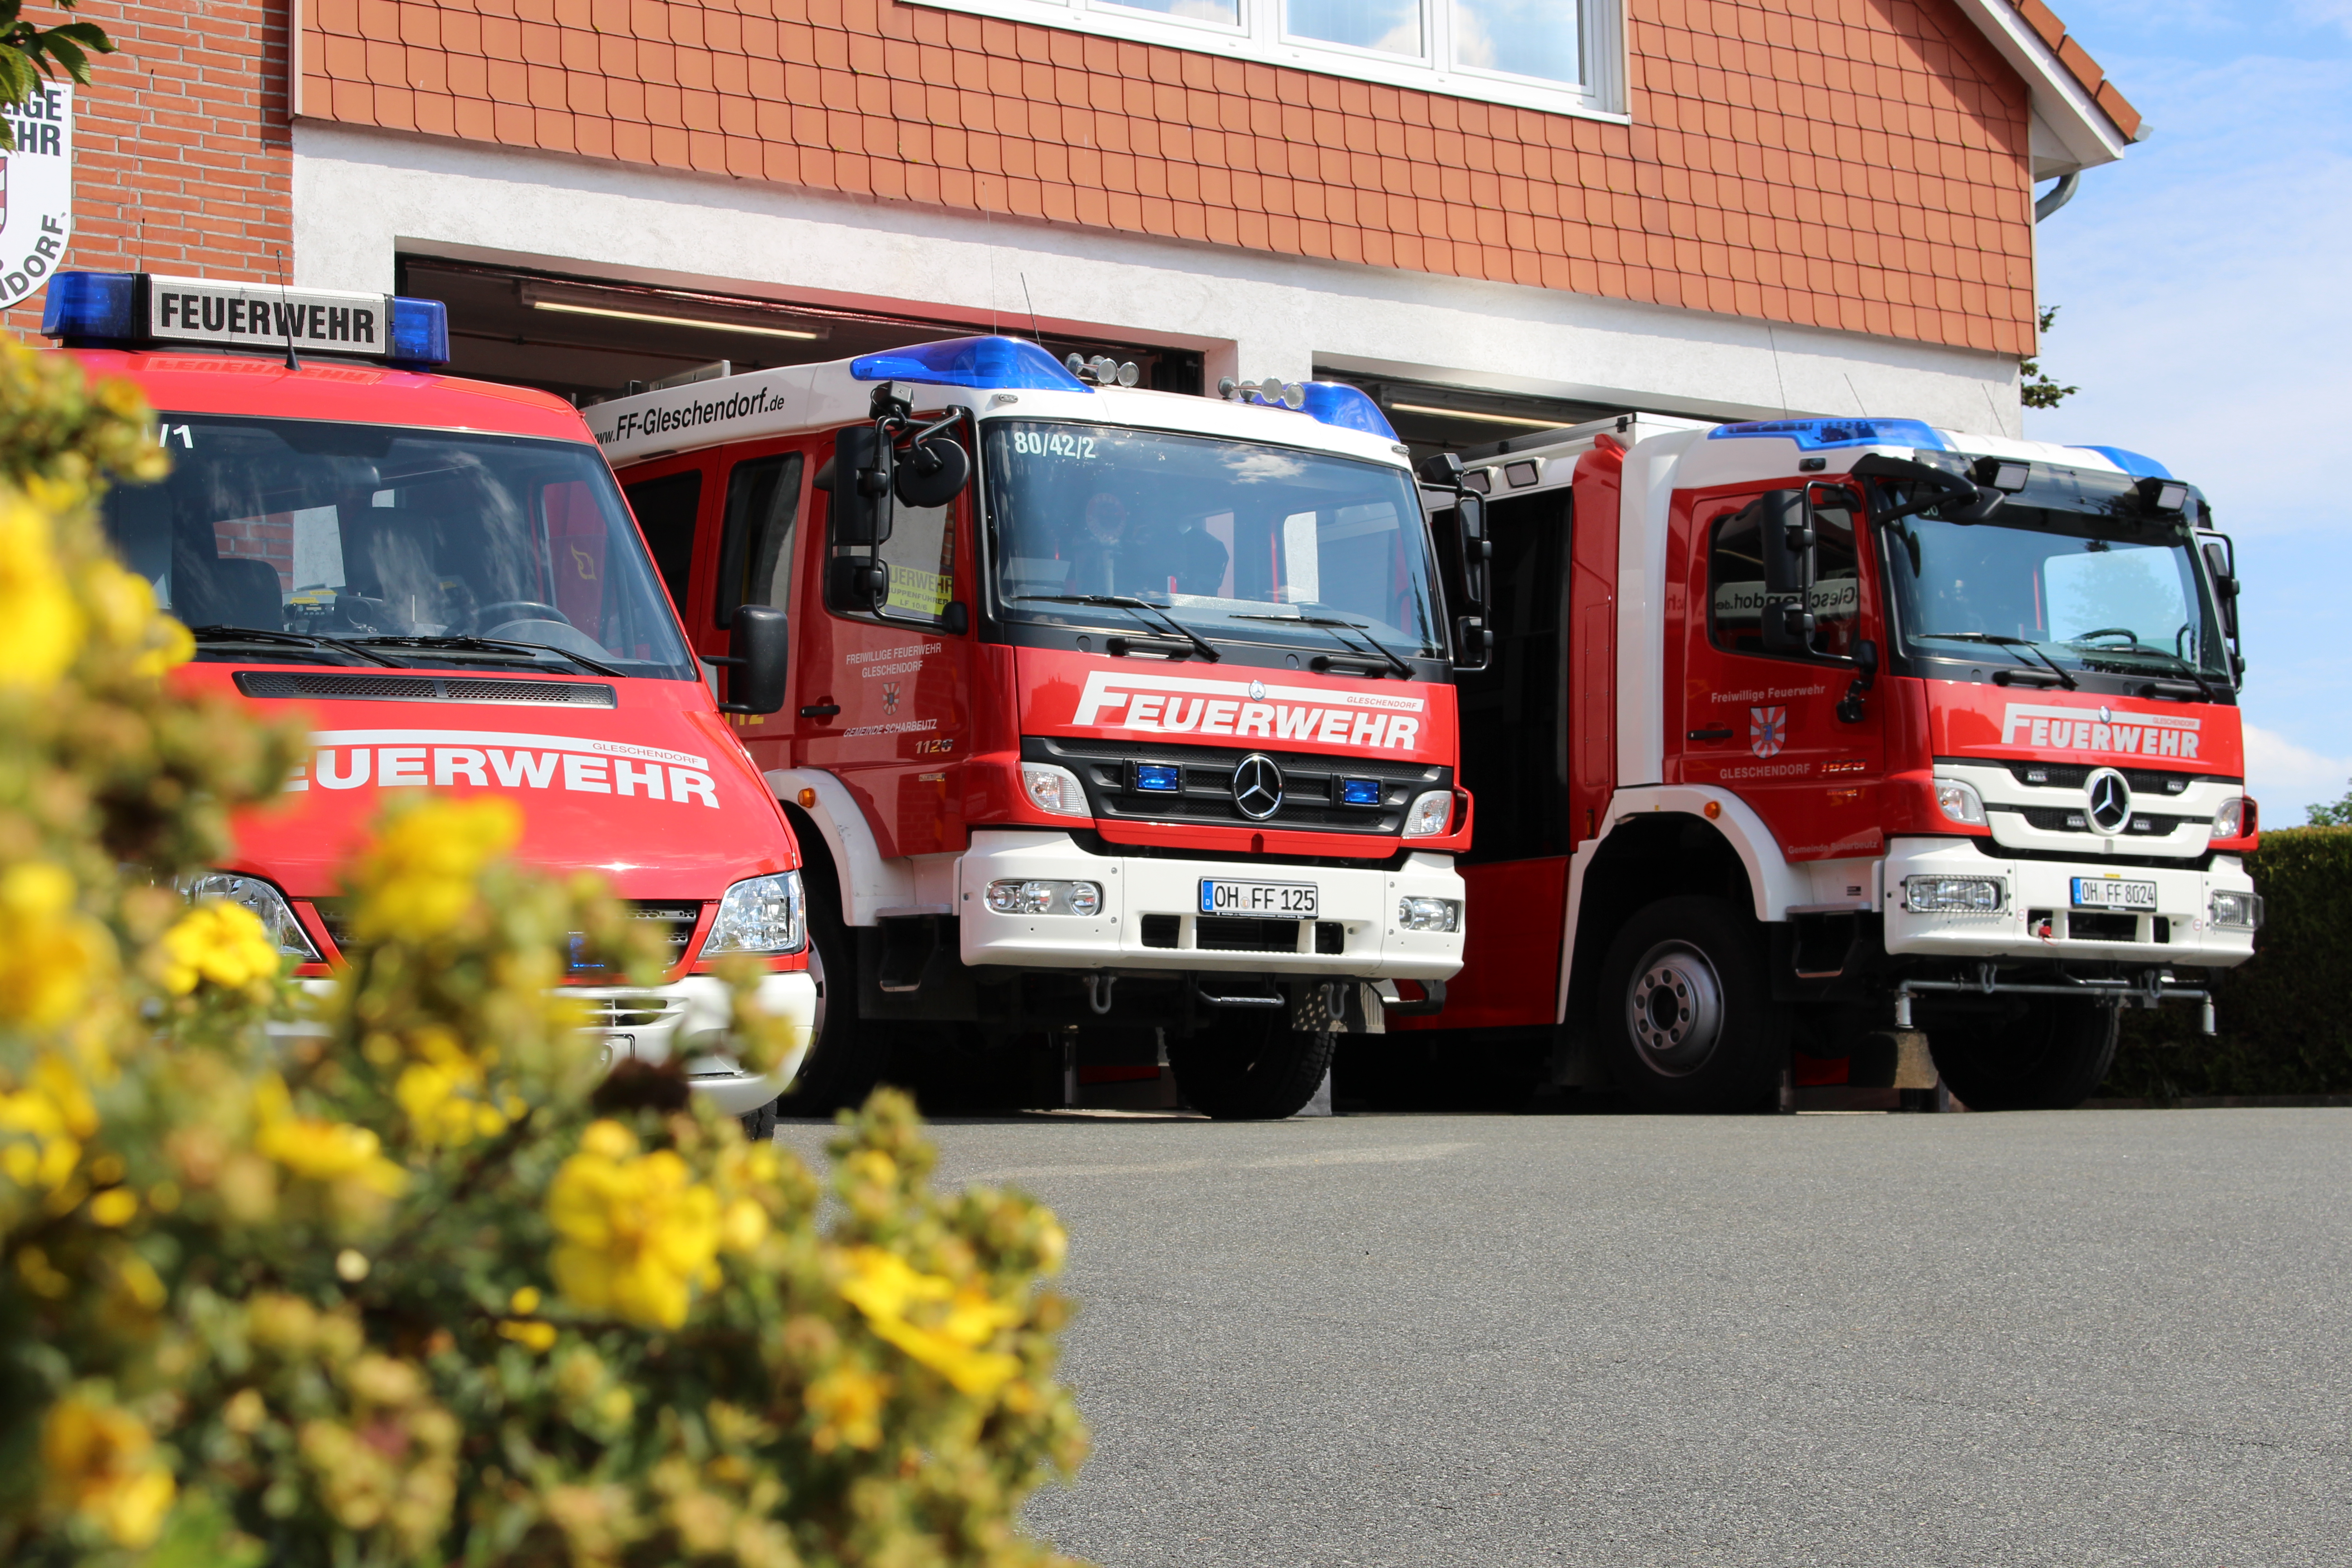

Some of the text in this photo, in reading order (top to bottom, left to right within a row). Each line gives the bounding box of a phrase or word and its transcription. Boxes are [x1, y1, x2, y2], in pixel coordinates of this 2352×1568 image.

[162, 293, 374, 343] FEUERWEHR
[595, 387, 784, 445] ww.FF-Gleschendorf.de
[1014, 431, 1096, 460] 80/42/2
[889, 567, 952, 593] UERWEHR
[912, 602, 927, 611] 10/6
[846, 642, 941, 665] FREIWILLIGE FEUERWEHR
[862, 660, 923, 678] GLESCHENDORF
[1347, 696, 1417, 709] GLESCHENDORF
[1711, 684, 1825, 703] Freiwillige Feuerwehr
[1072, 670, 1424, 750] FEUERWEHR
[843, 719, 937, 737] GEMEINDE SCHARBEUTZ
[2000, 703, 2200, 759] FEUERWEHR
[592, 743, 699, 764] GLESCHENDORF
[916, 739, 953, 754] 1126
[1720, 763, 1810, 779] GLESCHENDORF
[1788, 841, 1878, 854] Gemeinde Scharbeutz
[1215, 885, 1239, 907] OH
[1252, 888, 1275, 909] FF
[1280, 889, 1315, 911] 125
[2082, 882, 2097, 901] OH
[2107, 884, 2122, 902] FF
[2125, 885, 2154, 904] 8024
